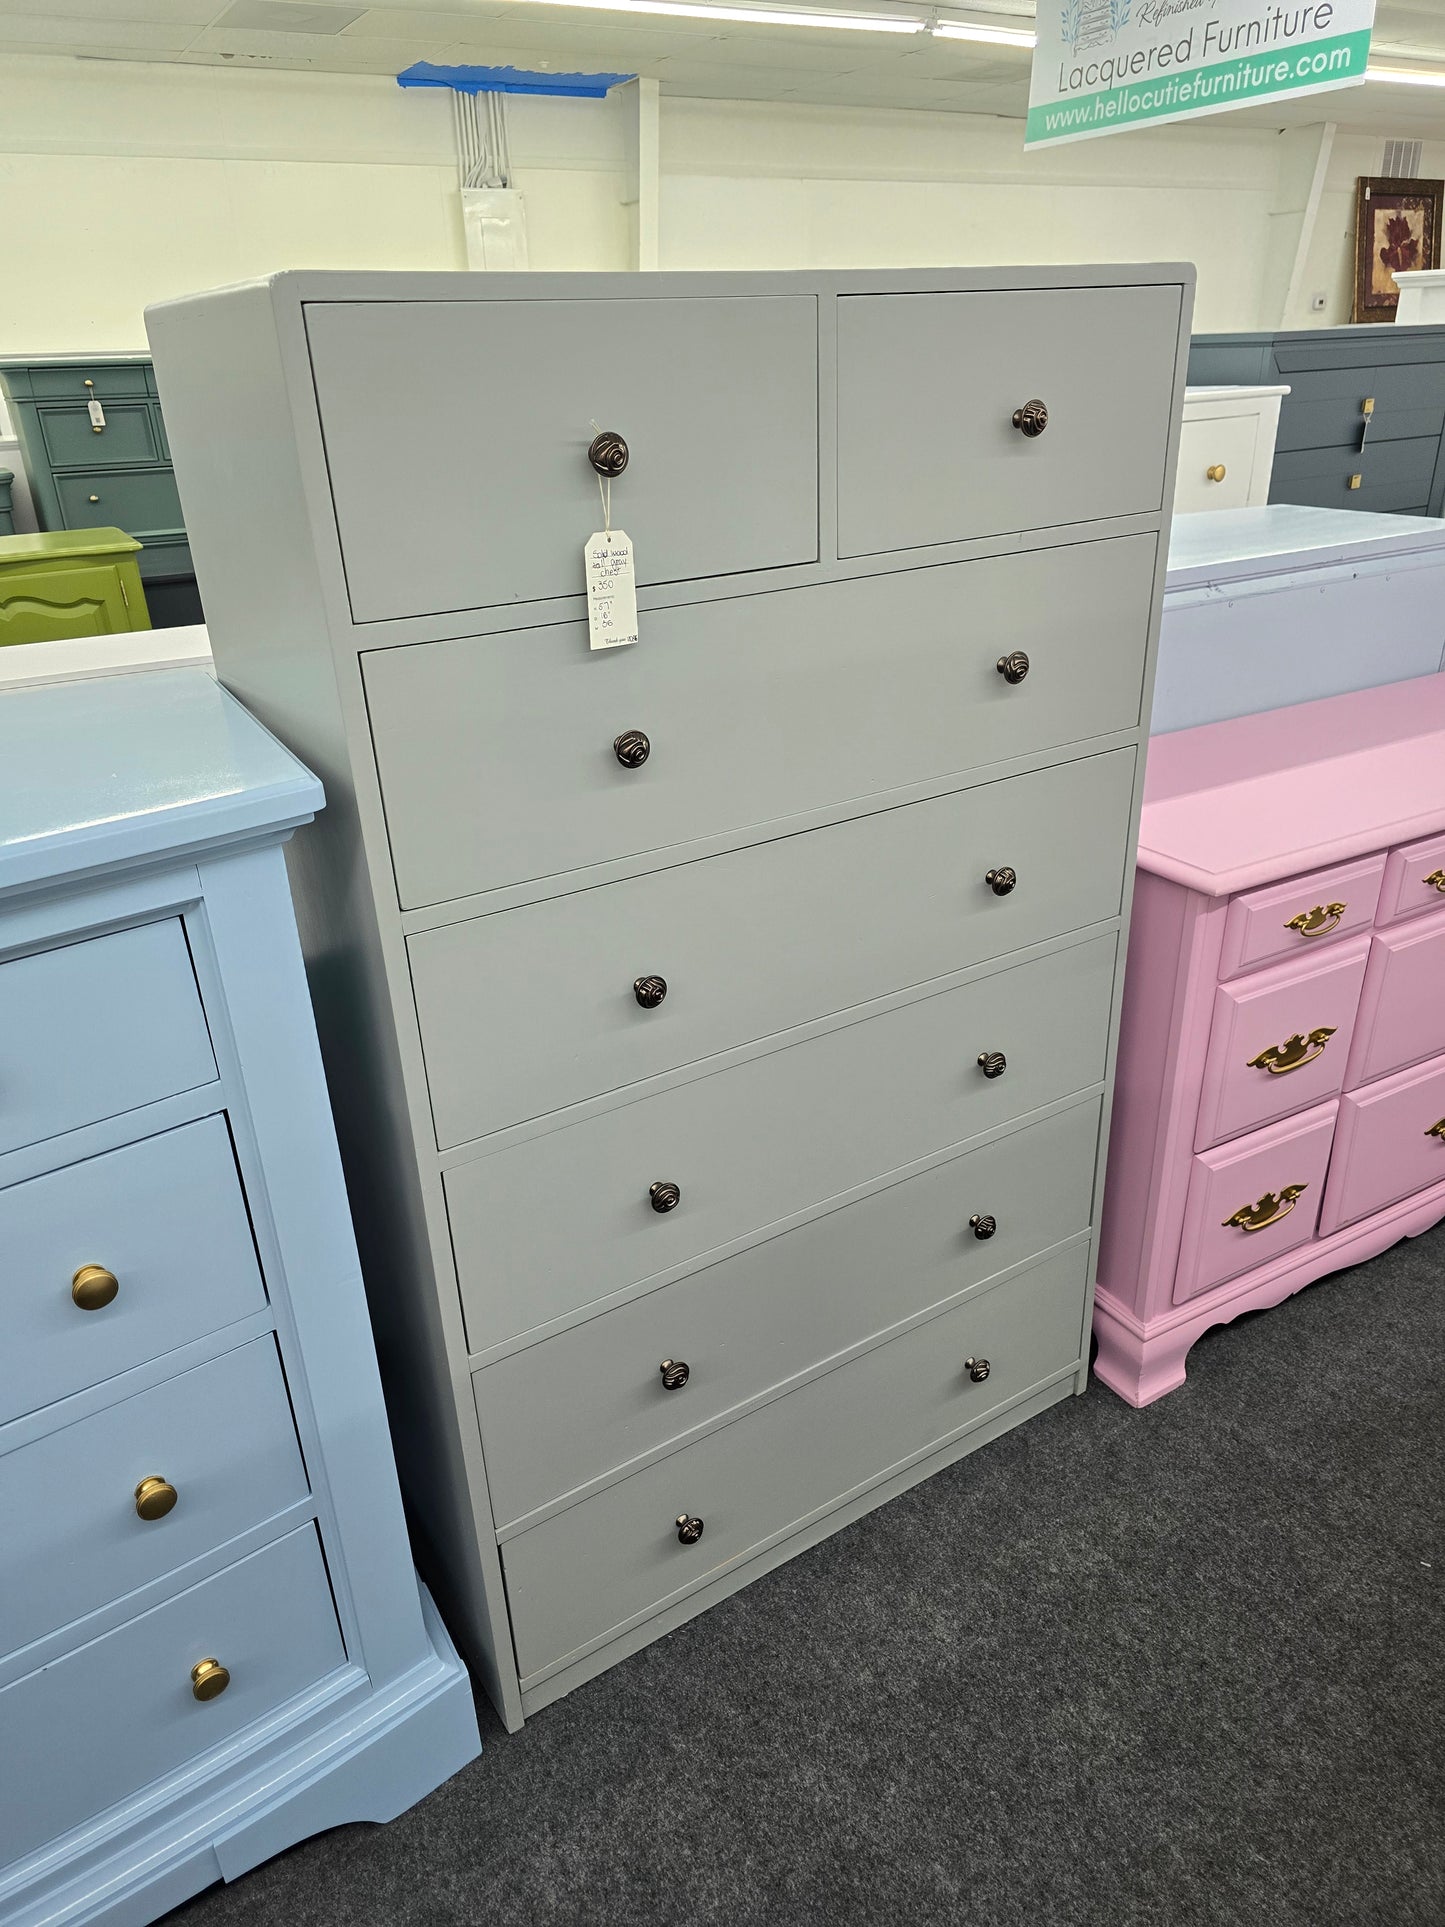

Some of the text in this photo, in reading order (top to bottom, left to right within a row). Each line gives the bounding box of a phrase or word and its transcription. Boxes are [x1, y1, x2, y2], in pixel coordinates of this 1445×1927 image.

[1046, 46, 1351, 131] www.hellocutiefurniture.com
[1058, 3, 1334, 93] Lacquered Furniture
